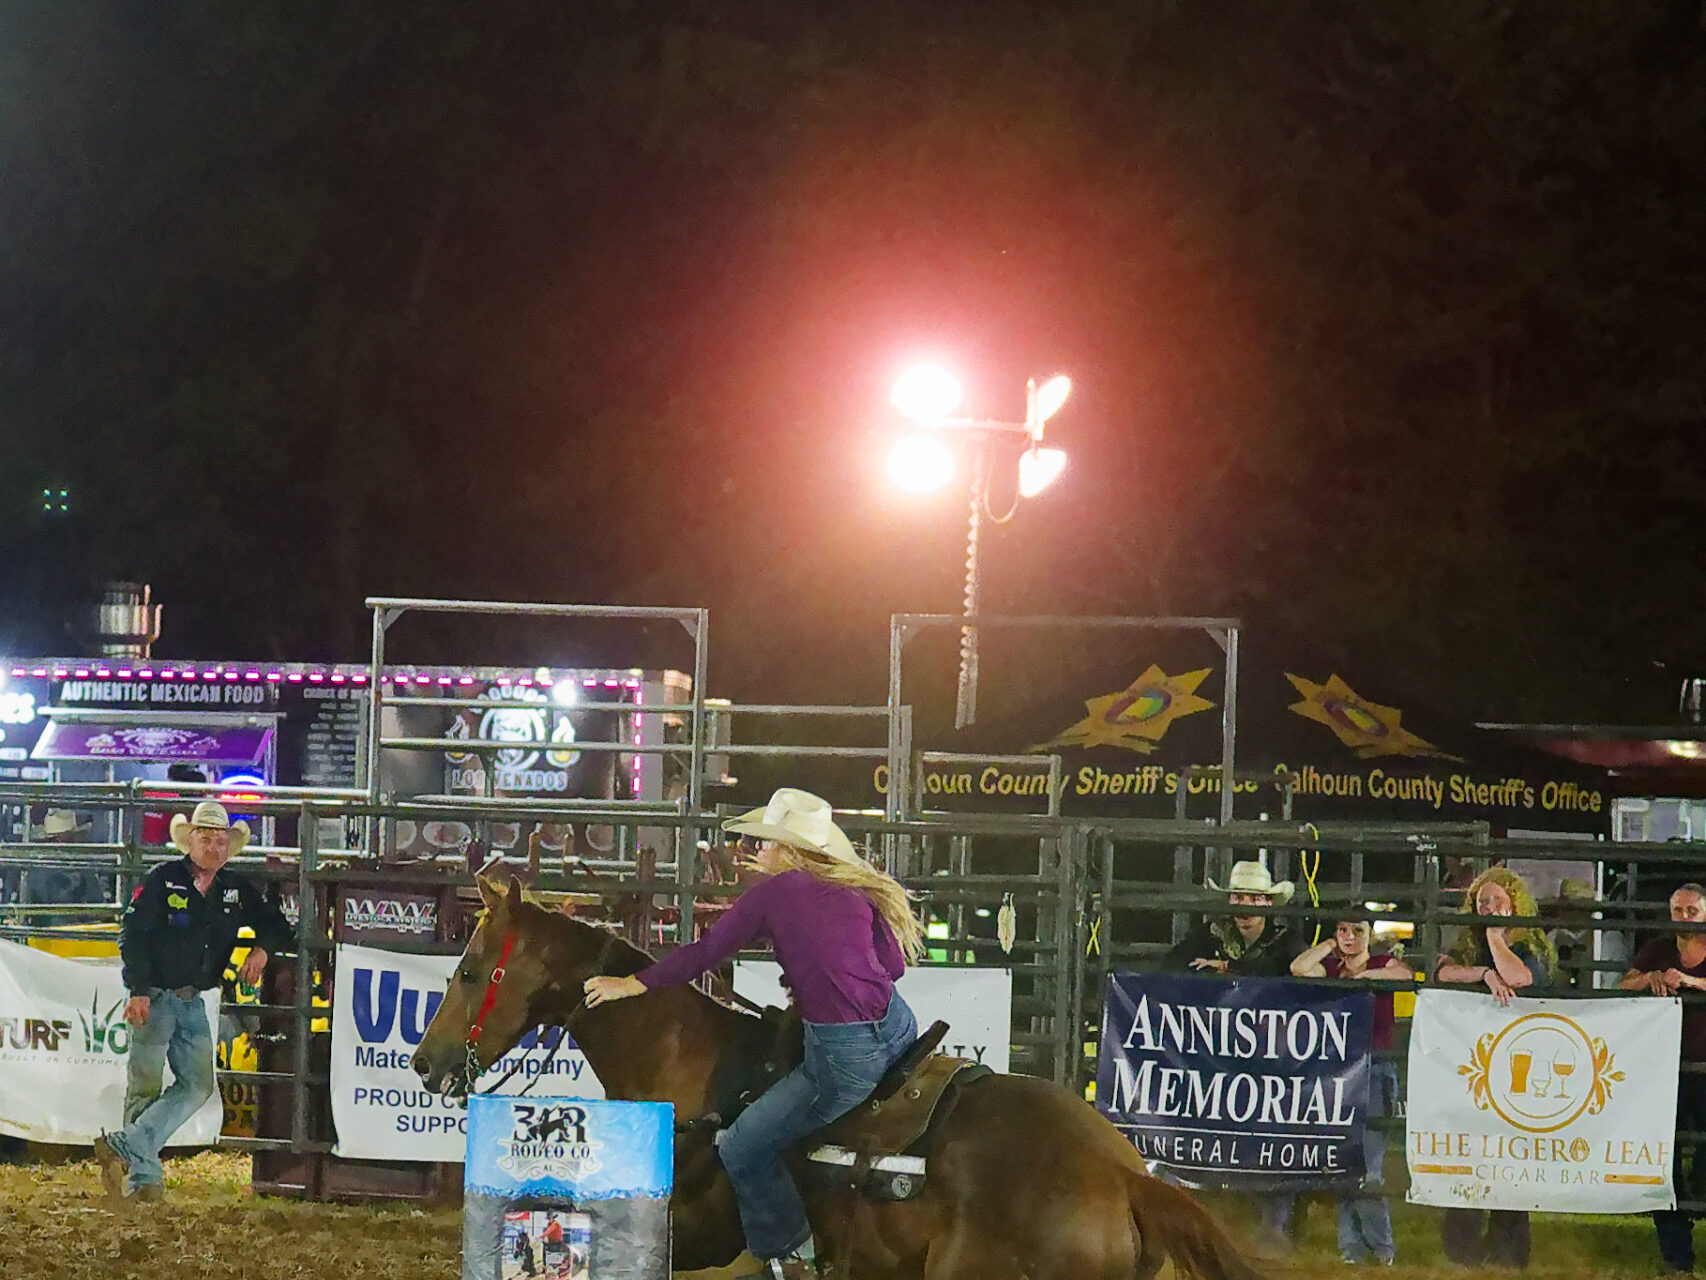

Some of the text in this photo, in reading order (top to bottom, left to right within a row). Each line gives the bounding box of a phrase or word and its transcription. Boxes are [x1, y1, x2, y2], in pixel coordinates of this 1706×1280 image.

[61, 681, 264, 704] AUTHENTIC MEXICAN FOOD
[1077, 765, 1178, 795] Sheriff's
[1368, 768, 1444, 808] County
[1451, 774, 1534, 809] Sheriff's
[1542, 780, 1601, 812] Office
[1123, 994, 1351, 1061] ANNISTON
[488, 1056, 585, 1081] ompany
[354, 1087, 433, 1108] PROUD
[1108, 1058, 1356, 1126] MEMORIAL
[511, 1144, 565, 1158] RODEO
[1123, 1134, 1338, 1167] UNERAL HOME
[1411, 1131, 1670, 1166] THE LIGERO LEAF
[1475, 1164, 1600, 1185] CIGAR BAR
